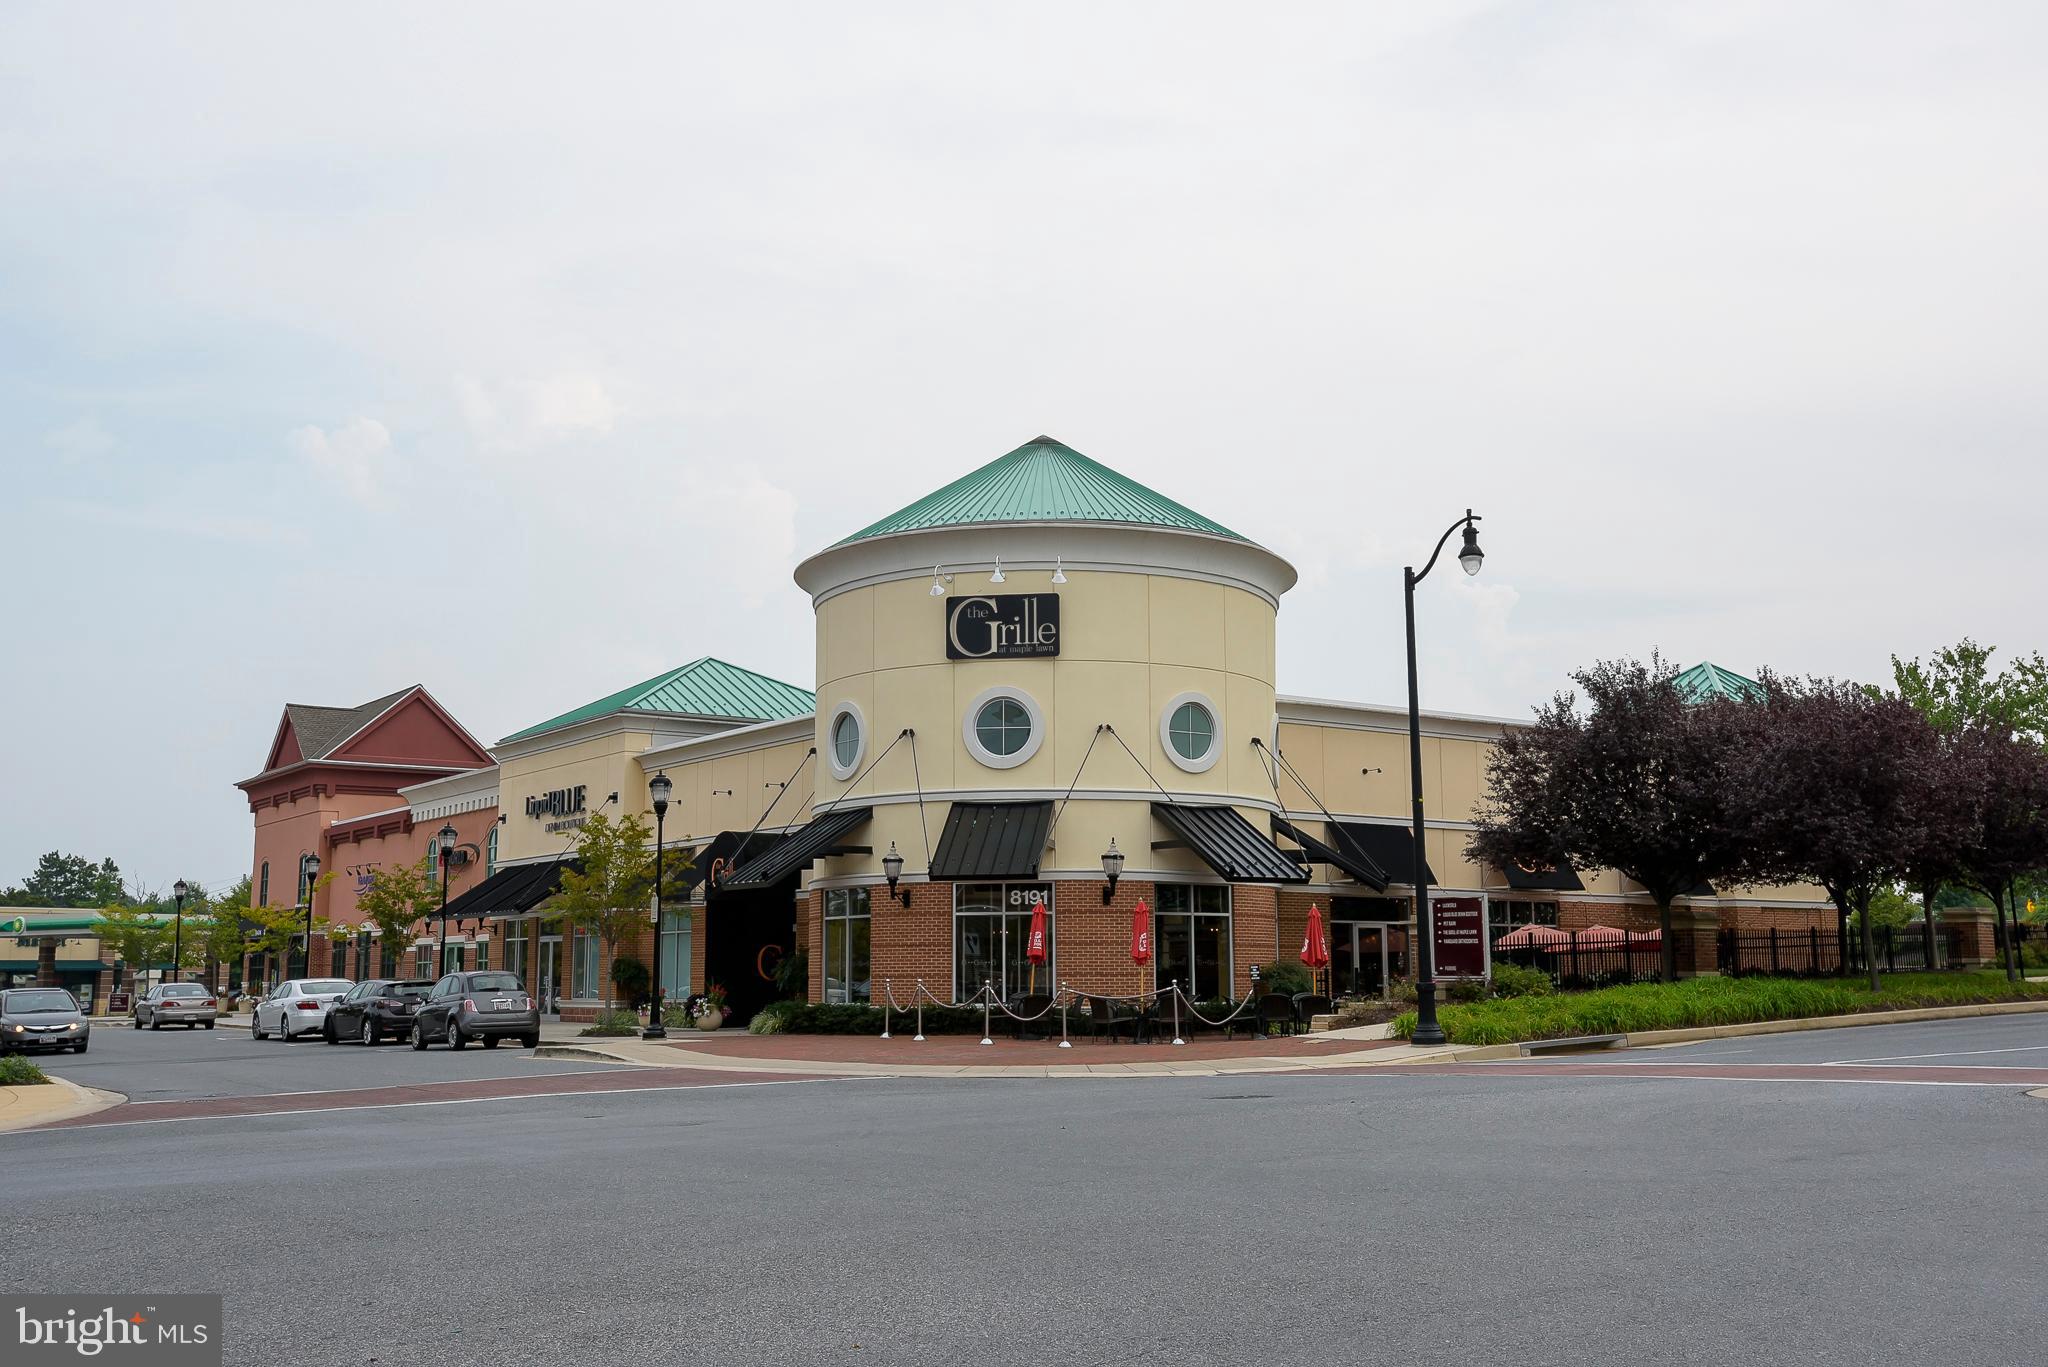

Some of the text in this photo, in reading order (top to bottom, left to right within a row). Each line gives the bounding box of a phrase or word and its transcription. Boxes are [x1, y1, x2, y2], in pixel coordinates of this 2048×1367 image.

[967, 606, 989, 618] the
[949, 597, 1057, 657] Grille
[998, 643, 1054, 654] at maple lawn
[1010, 890, 1048, 905] 8191
